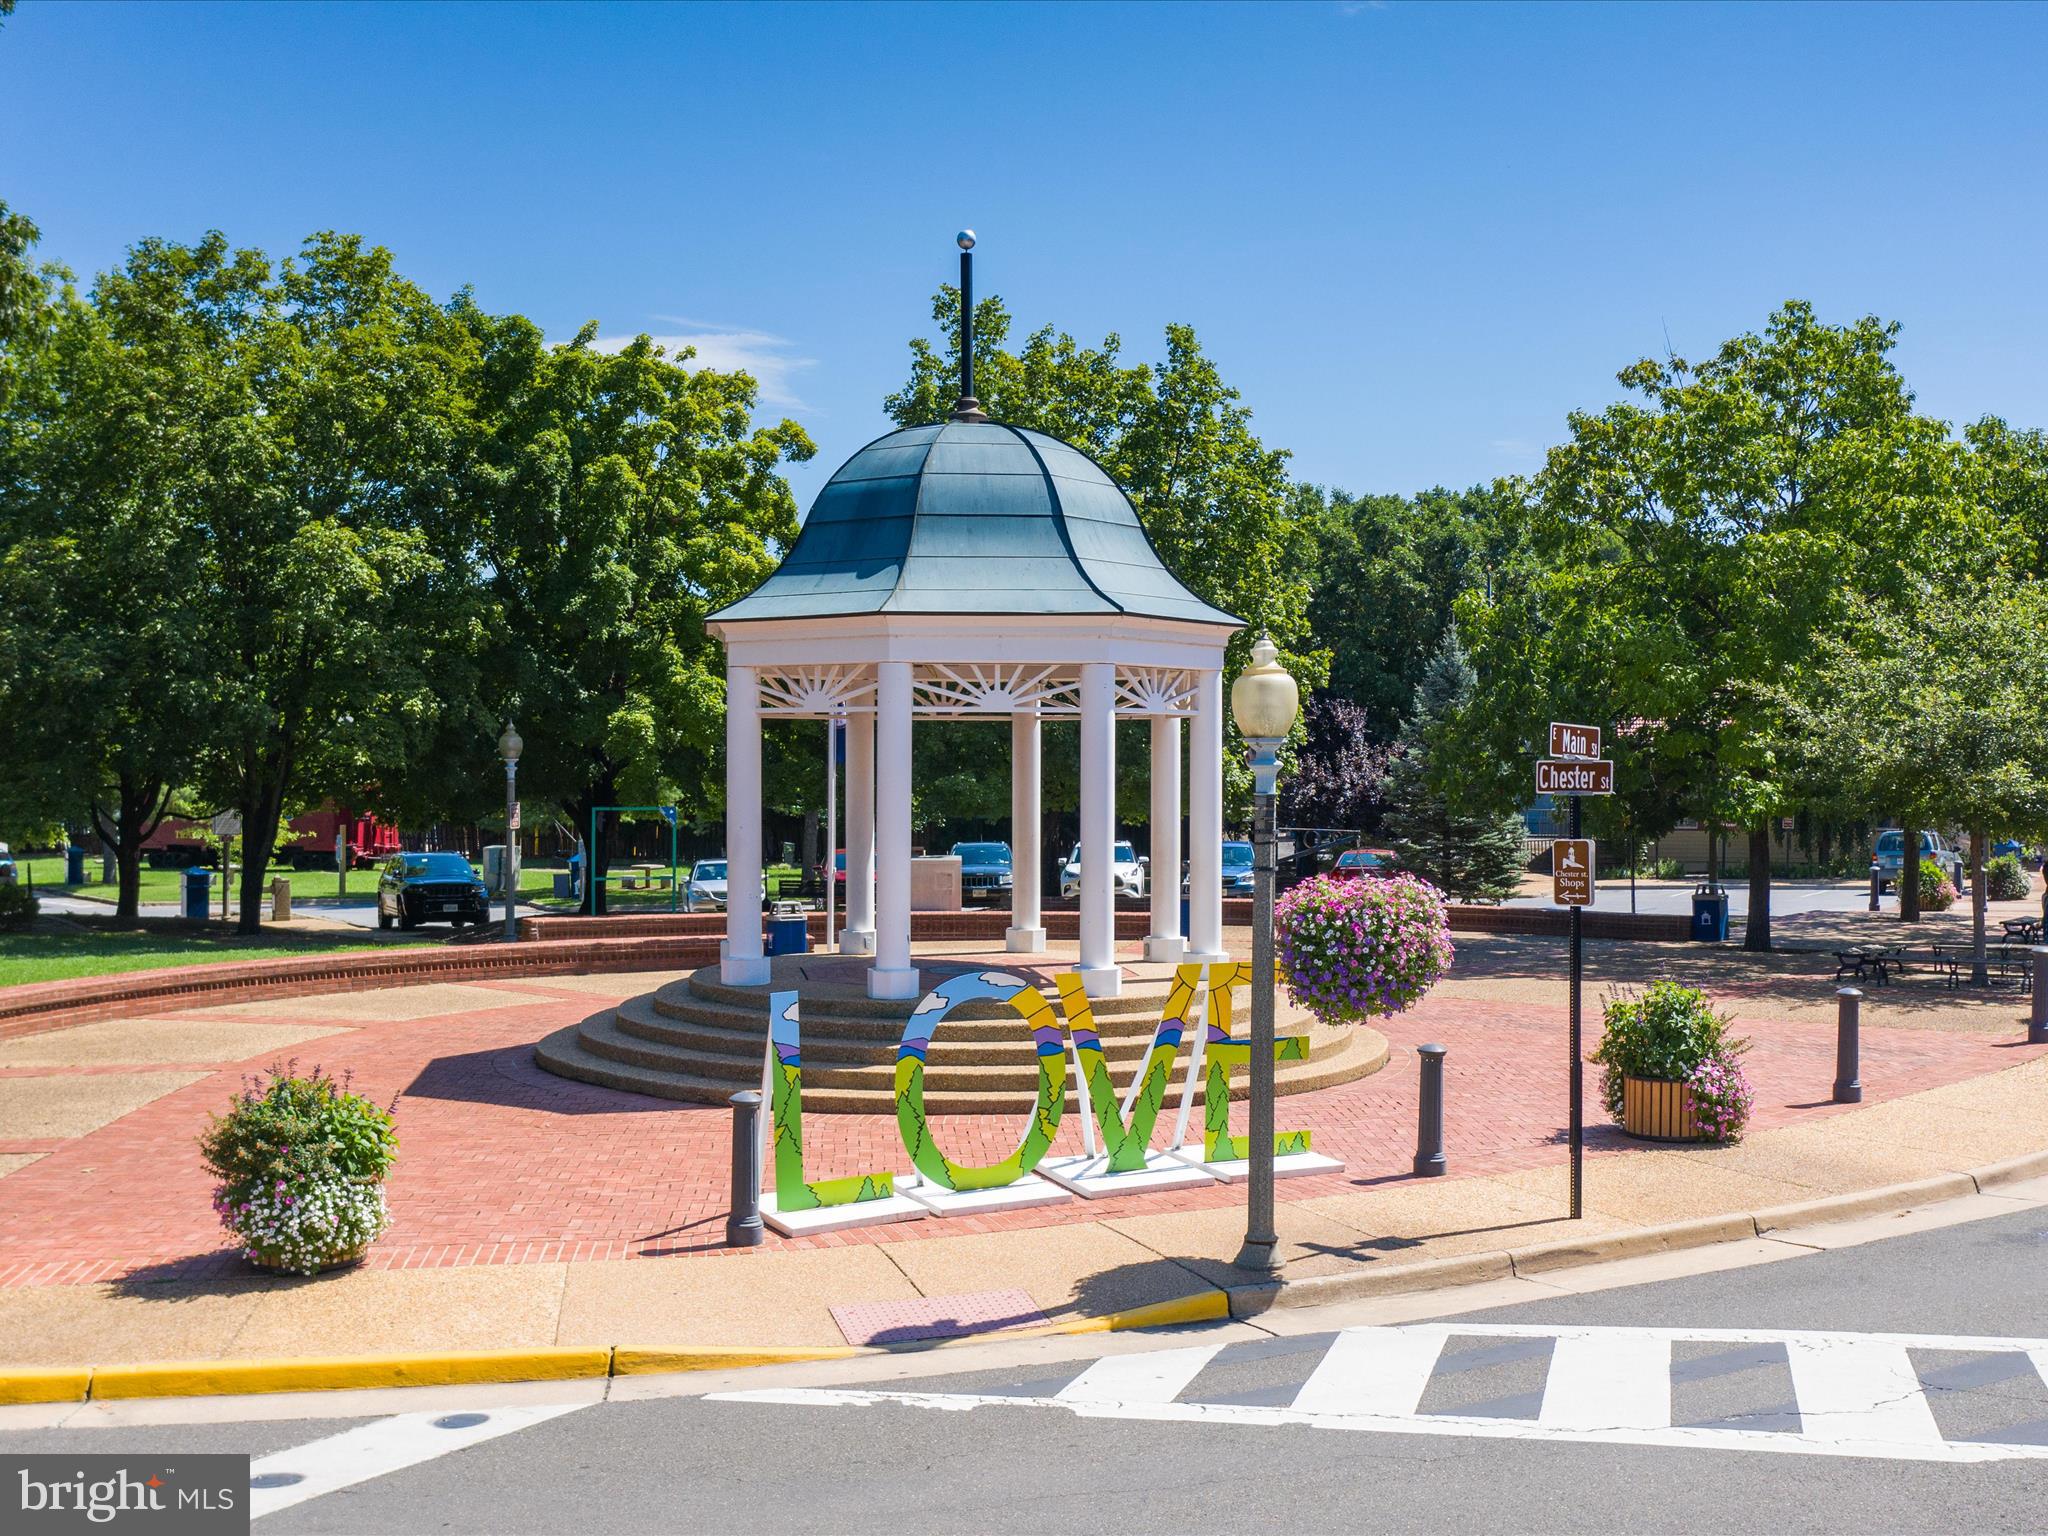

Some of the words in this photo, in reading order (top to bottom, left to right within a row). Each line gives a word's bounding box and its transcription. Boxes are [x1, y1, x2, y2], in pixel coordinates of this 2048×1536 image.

[1553, 727, 1557, 740] E
[1562, 729, 1586, 755] Main
[1591, 743, 1598, 756] St
[1539, 765, 1596, 789] Chester
[1600, 776, 1610, 790] St
[1555, 870, 1580, 878] Chester
[1559, 878, 1585, 890] Shops
[770, 963, 1311, 1212] LOVE
